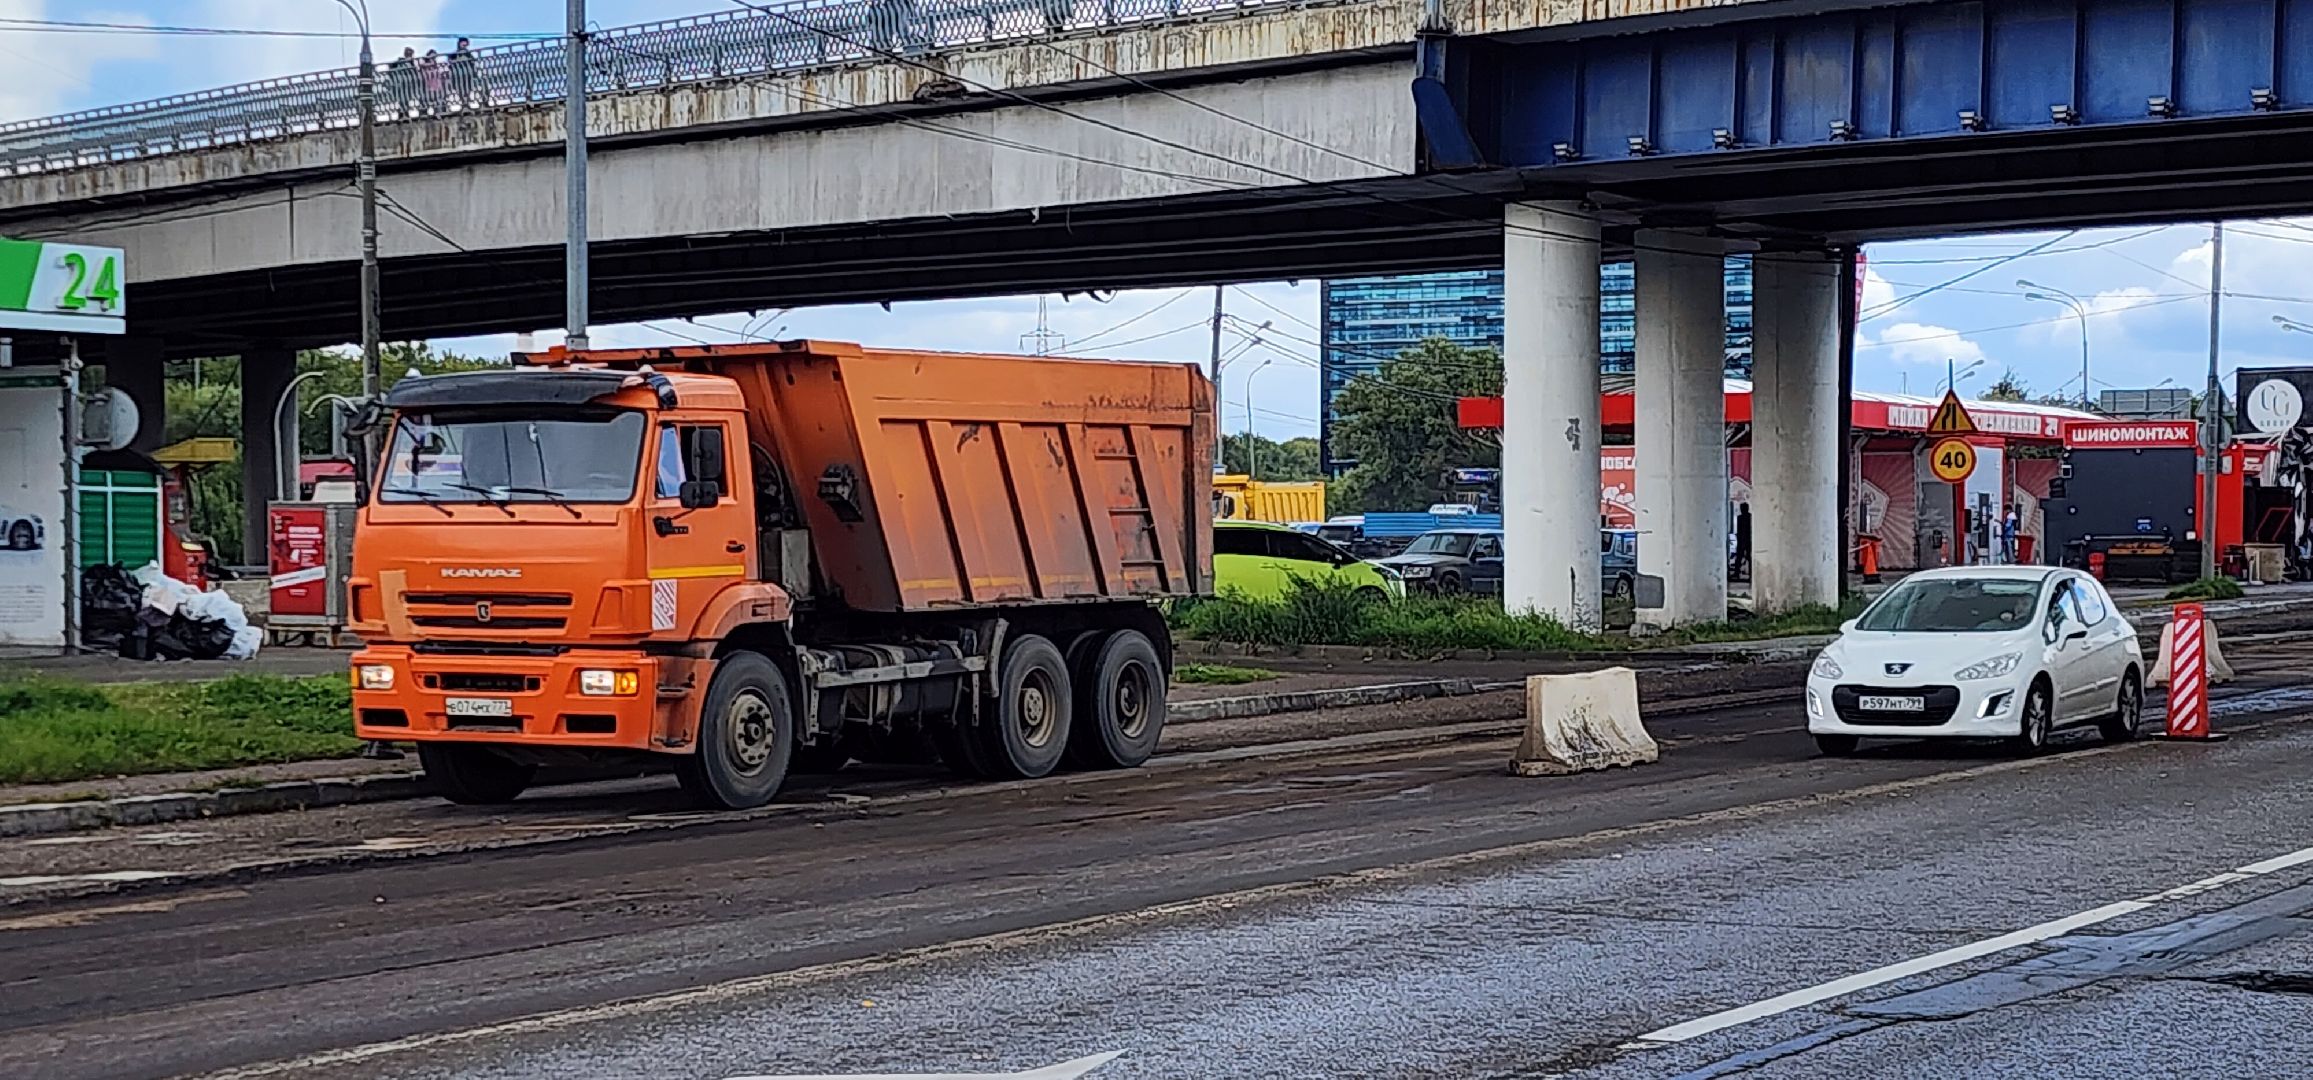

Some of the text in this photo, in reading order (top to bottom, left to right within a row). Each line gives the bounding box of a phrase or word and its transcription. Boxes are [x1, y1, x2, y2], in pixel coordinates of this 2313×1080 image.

[63, 252, 120, 310] 24
[2072, 427, 2190, 442] ШИНОМОНТАЖ
[1939, 451, 1967, 469] 40
[440, 567, 522, 578] KAMAZ
